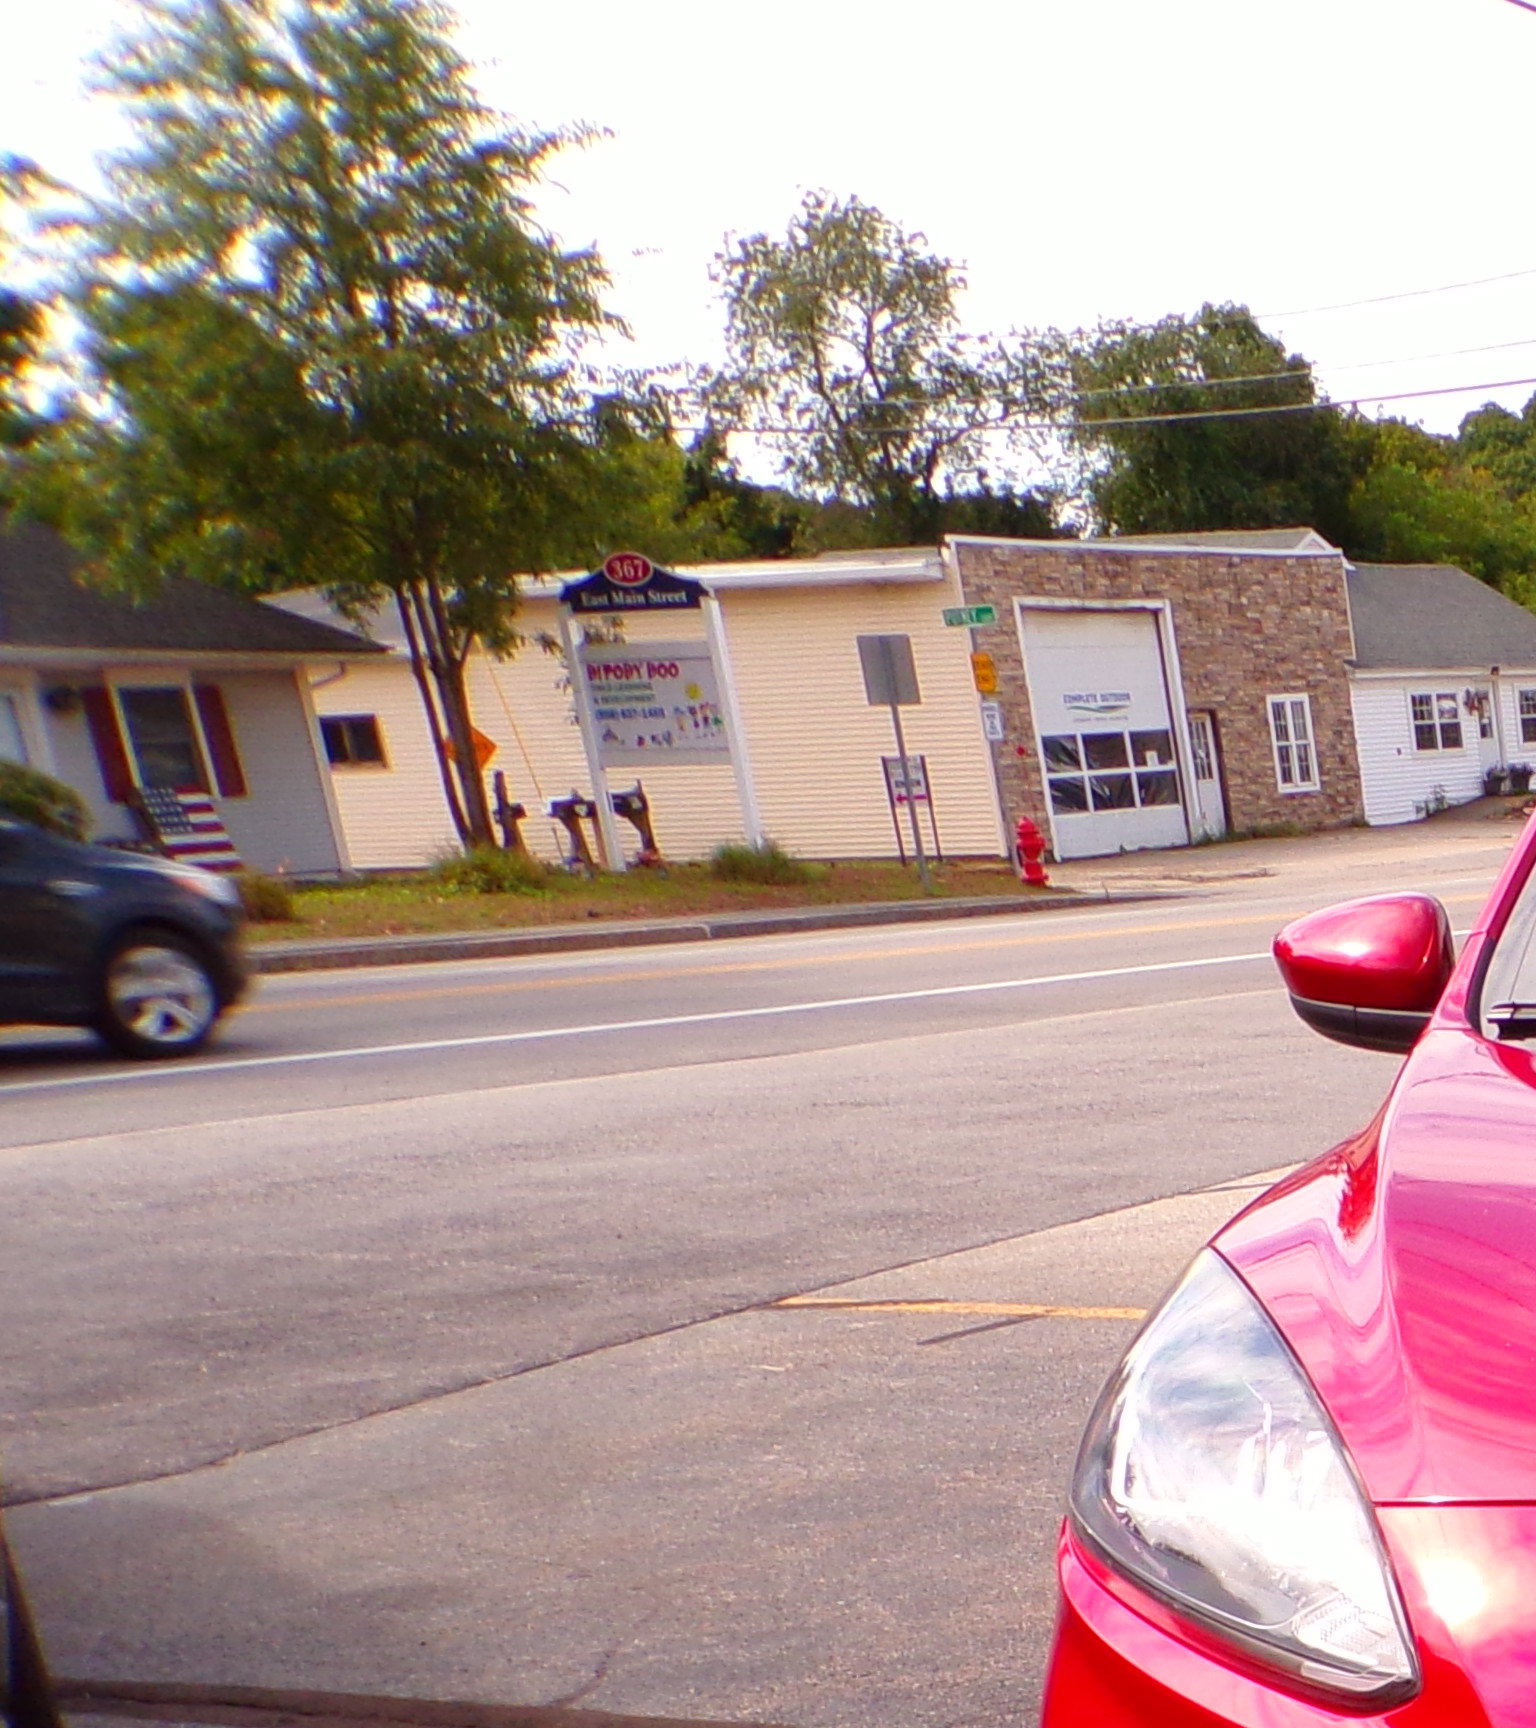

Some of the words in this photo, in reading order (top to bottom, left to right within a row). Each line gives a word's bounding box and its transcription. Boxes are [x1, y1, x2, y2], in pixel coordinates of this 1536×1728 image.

[611, 559, 644, 579] 367
[580, 591, 609, 606] East
[611, 590, 646, 605] Main
[648, 589, 688, 603] Street
